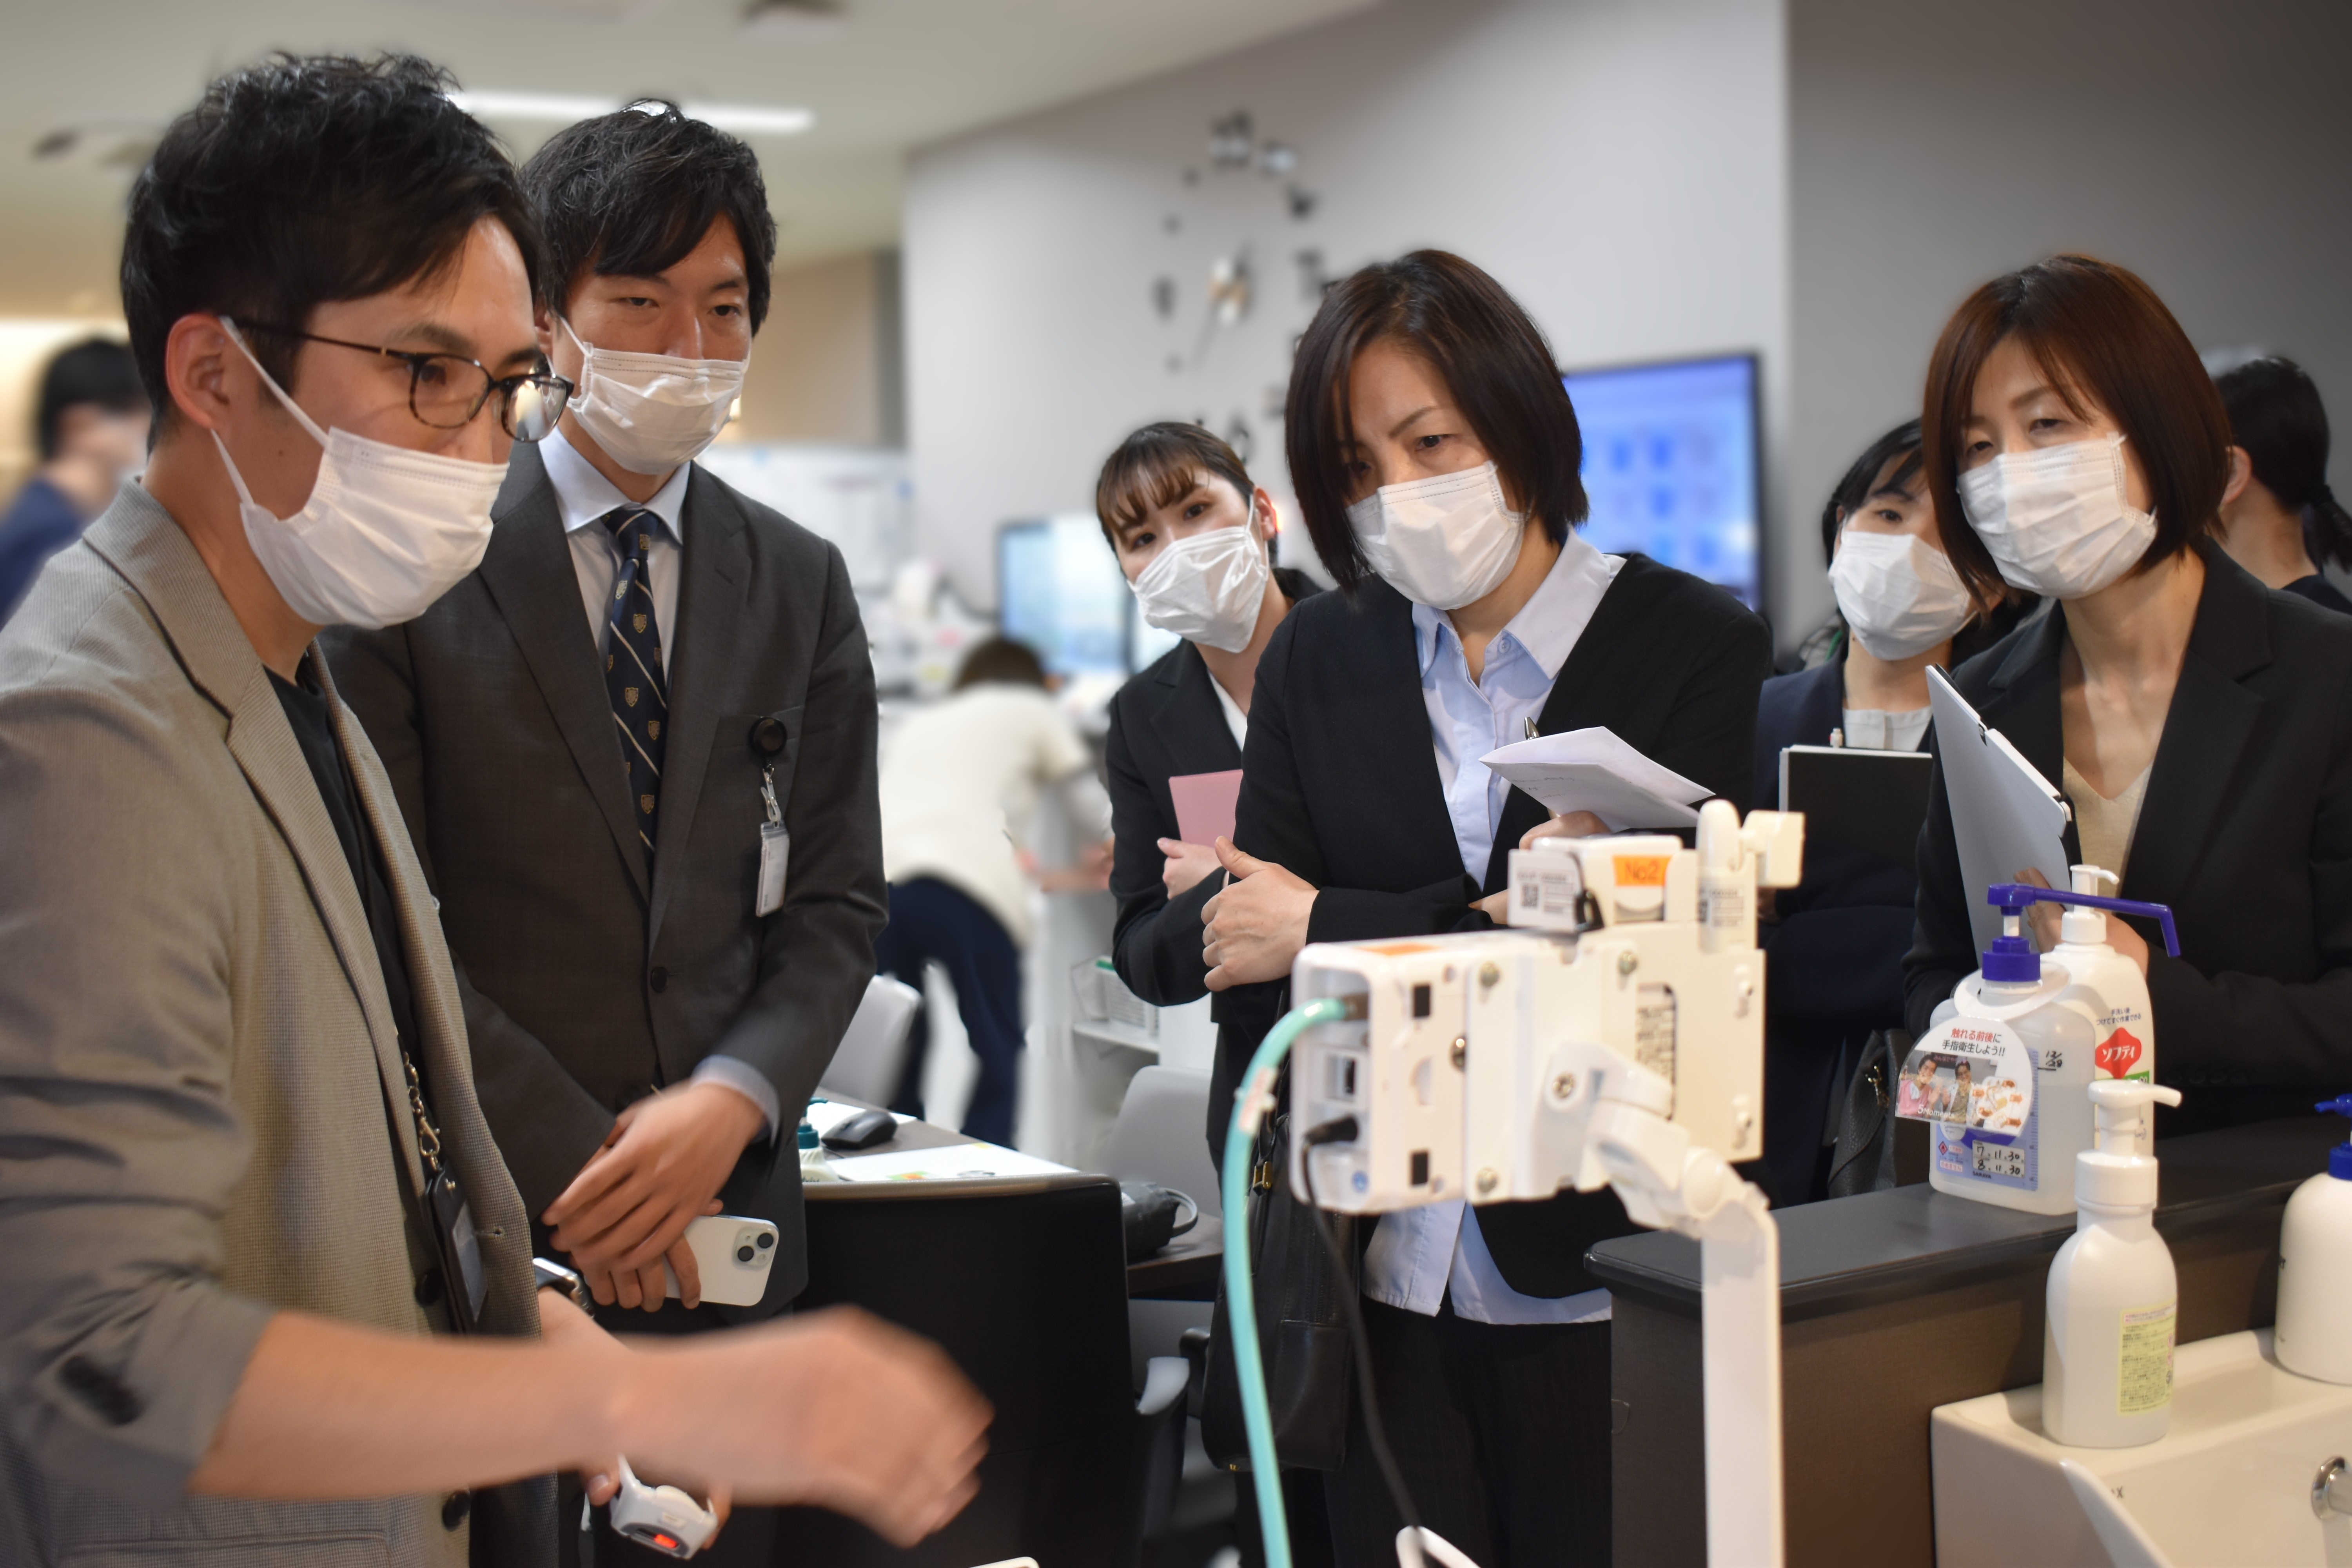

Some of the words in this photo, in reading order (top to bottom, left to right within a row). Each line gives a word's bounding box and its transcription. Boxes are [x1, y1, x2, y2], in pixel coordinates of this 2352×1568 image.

[1951, 1028, 2002, 1043] 触れる前後に
[2102, 1045, 2135, 1063] ソフティ
